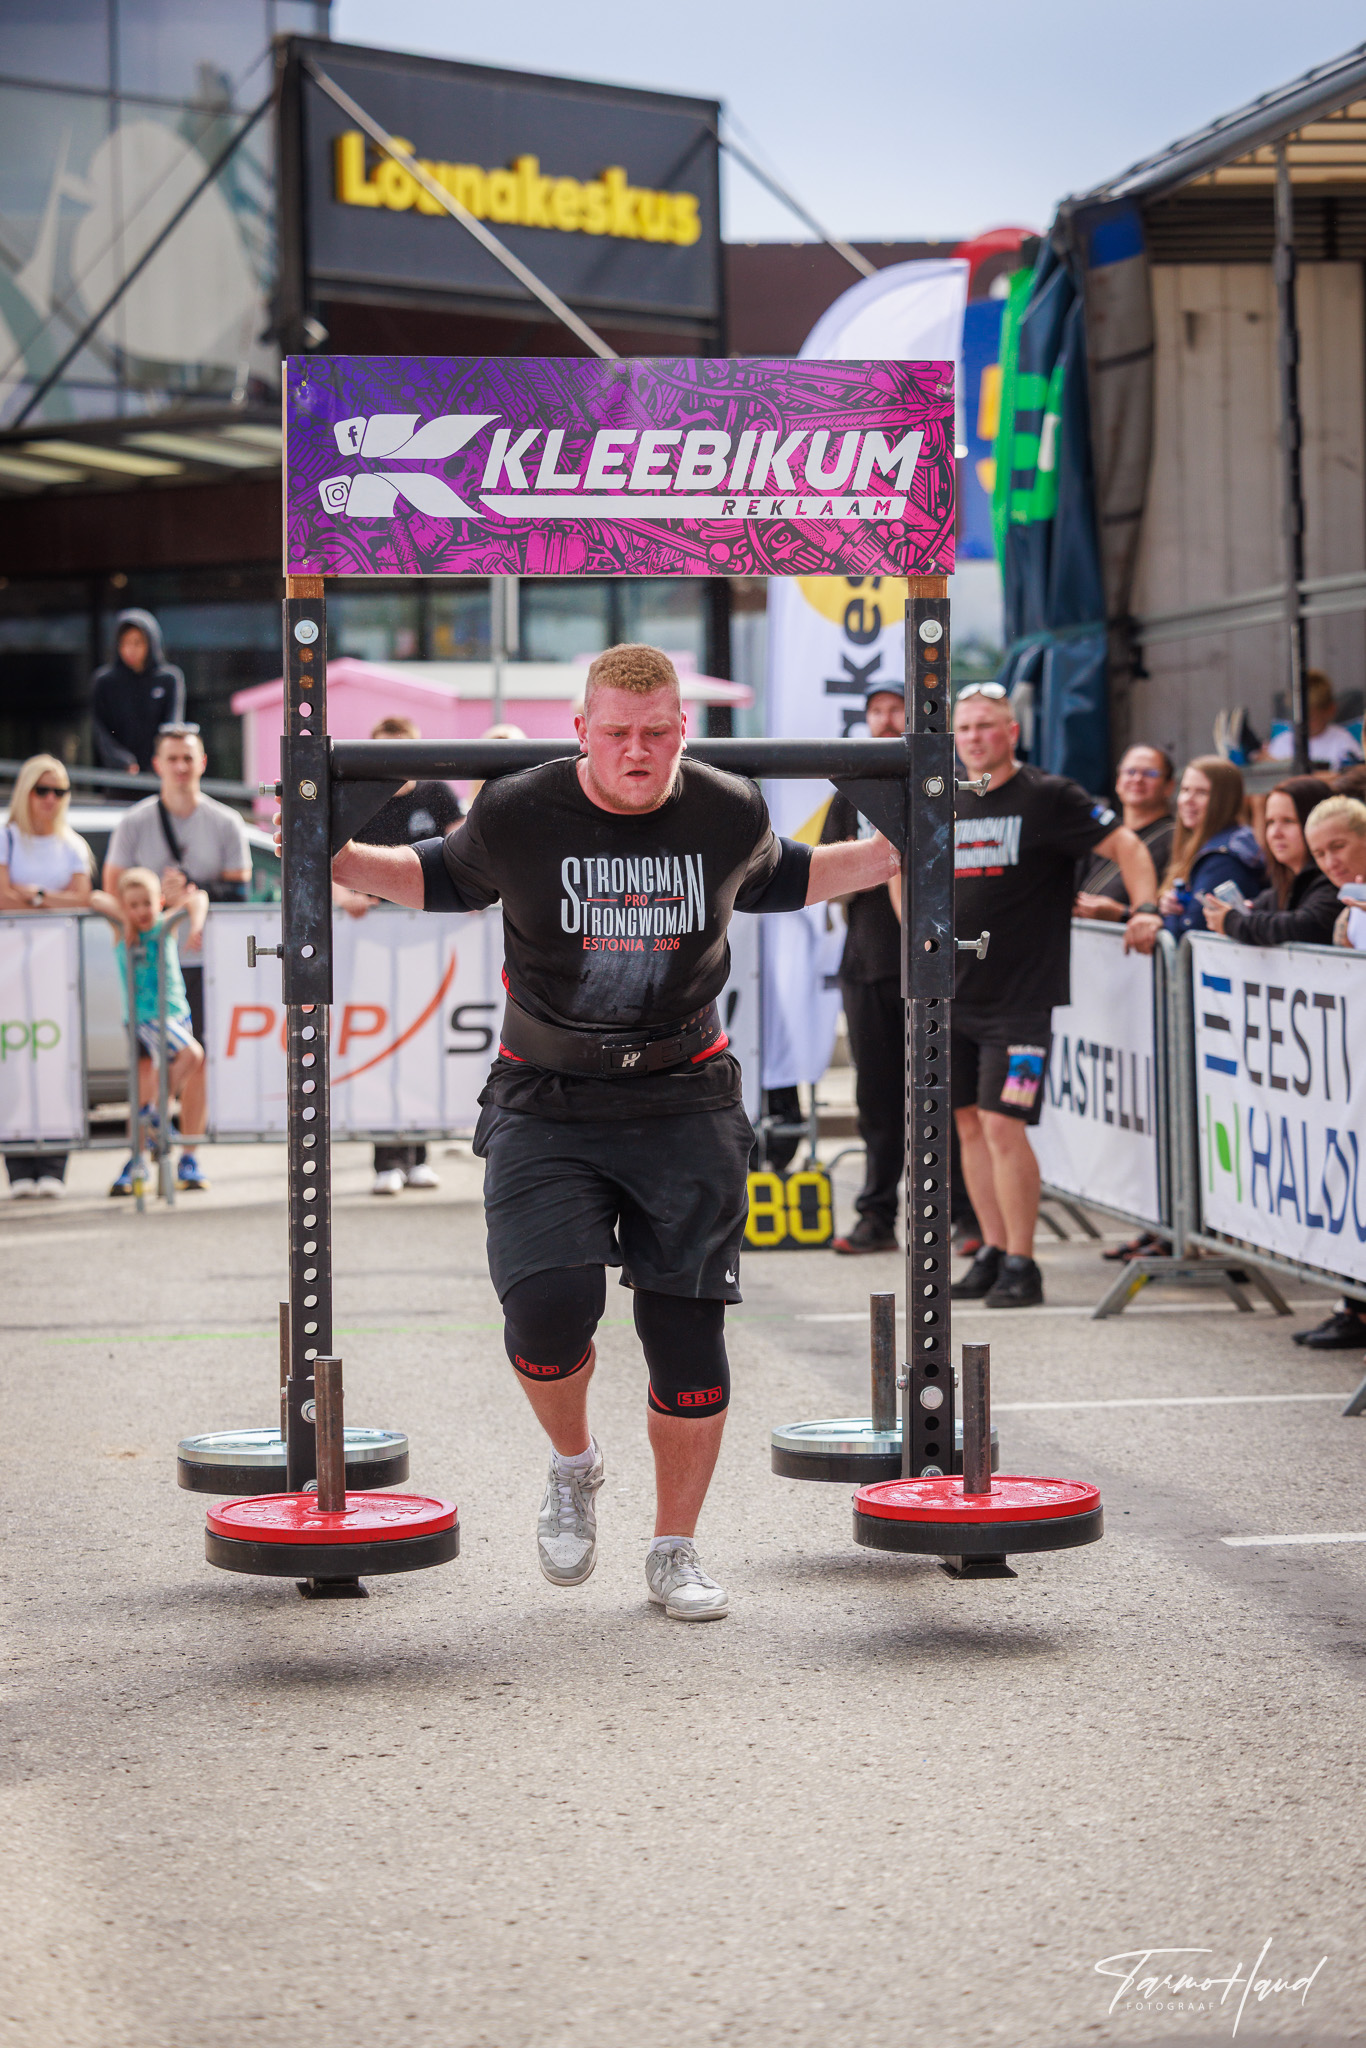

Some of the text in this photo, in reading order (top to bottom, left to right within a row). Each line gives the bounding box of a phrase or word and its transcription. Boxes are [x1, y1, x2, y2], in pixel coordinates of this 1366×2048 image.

[335, 129, 702, 247] Lõunakeskus
[480, 428, 925, 491] KLEEBIKUM
[721, 499, 893, 517] REKLAAM
[561, 854, 705, 933] STRONGMAN
[624, 894, 649, 907] PRO
[582, 937, 681, 952] ESTONIA 2026
[224, 1003, 389, 1059] PP
[1243, 977, 1352, 1104] EESTI
[744, 1171, 832, 1246] 80
[518, 1358, 556, 1375] SBD
[681, 1389, 720, 1405] SBD
